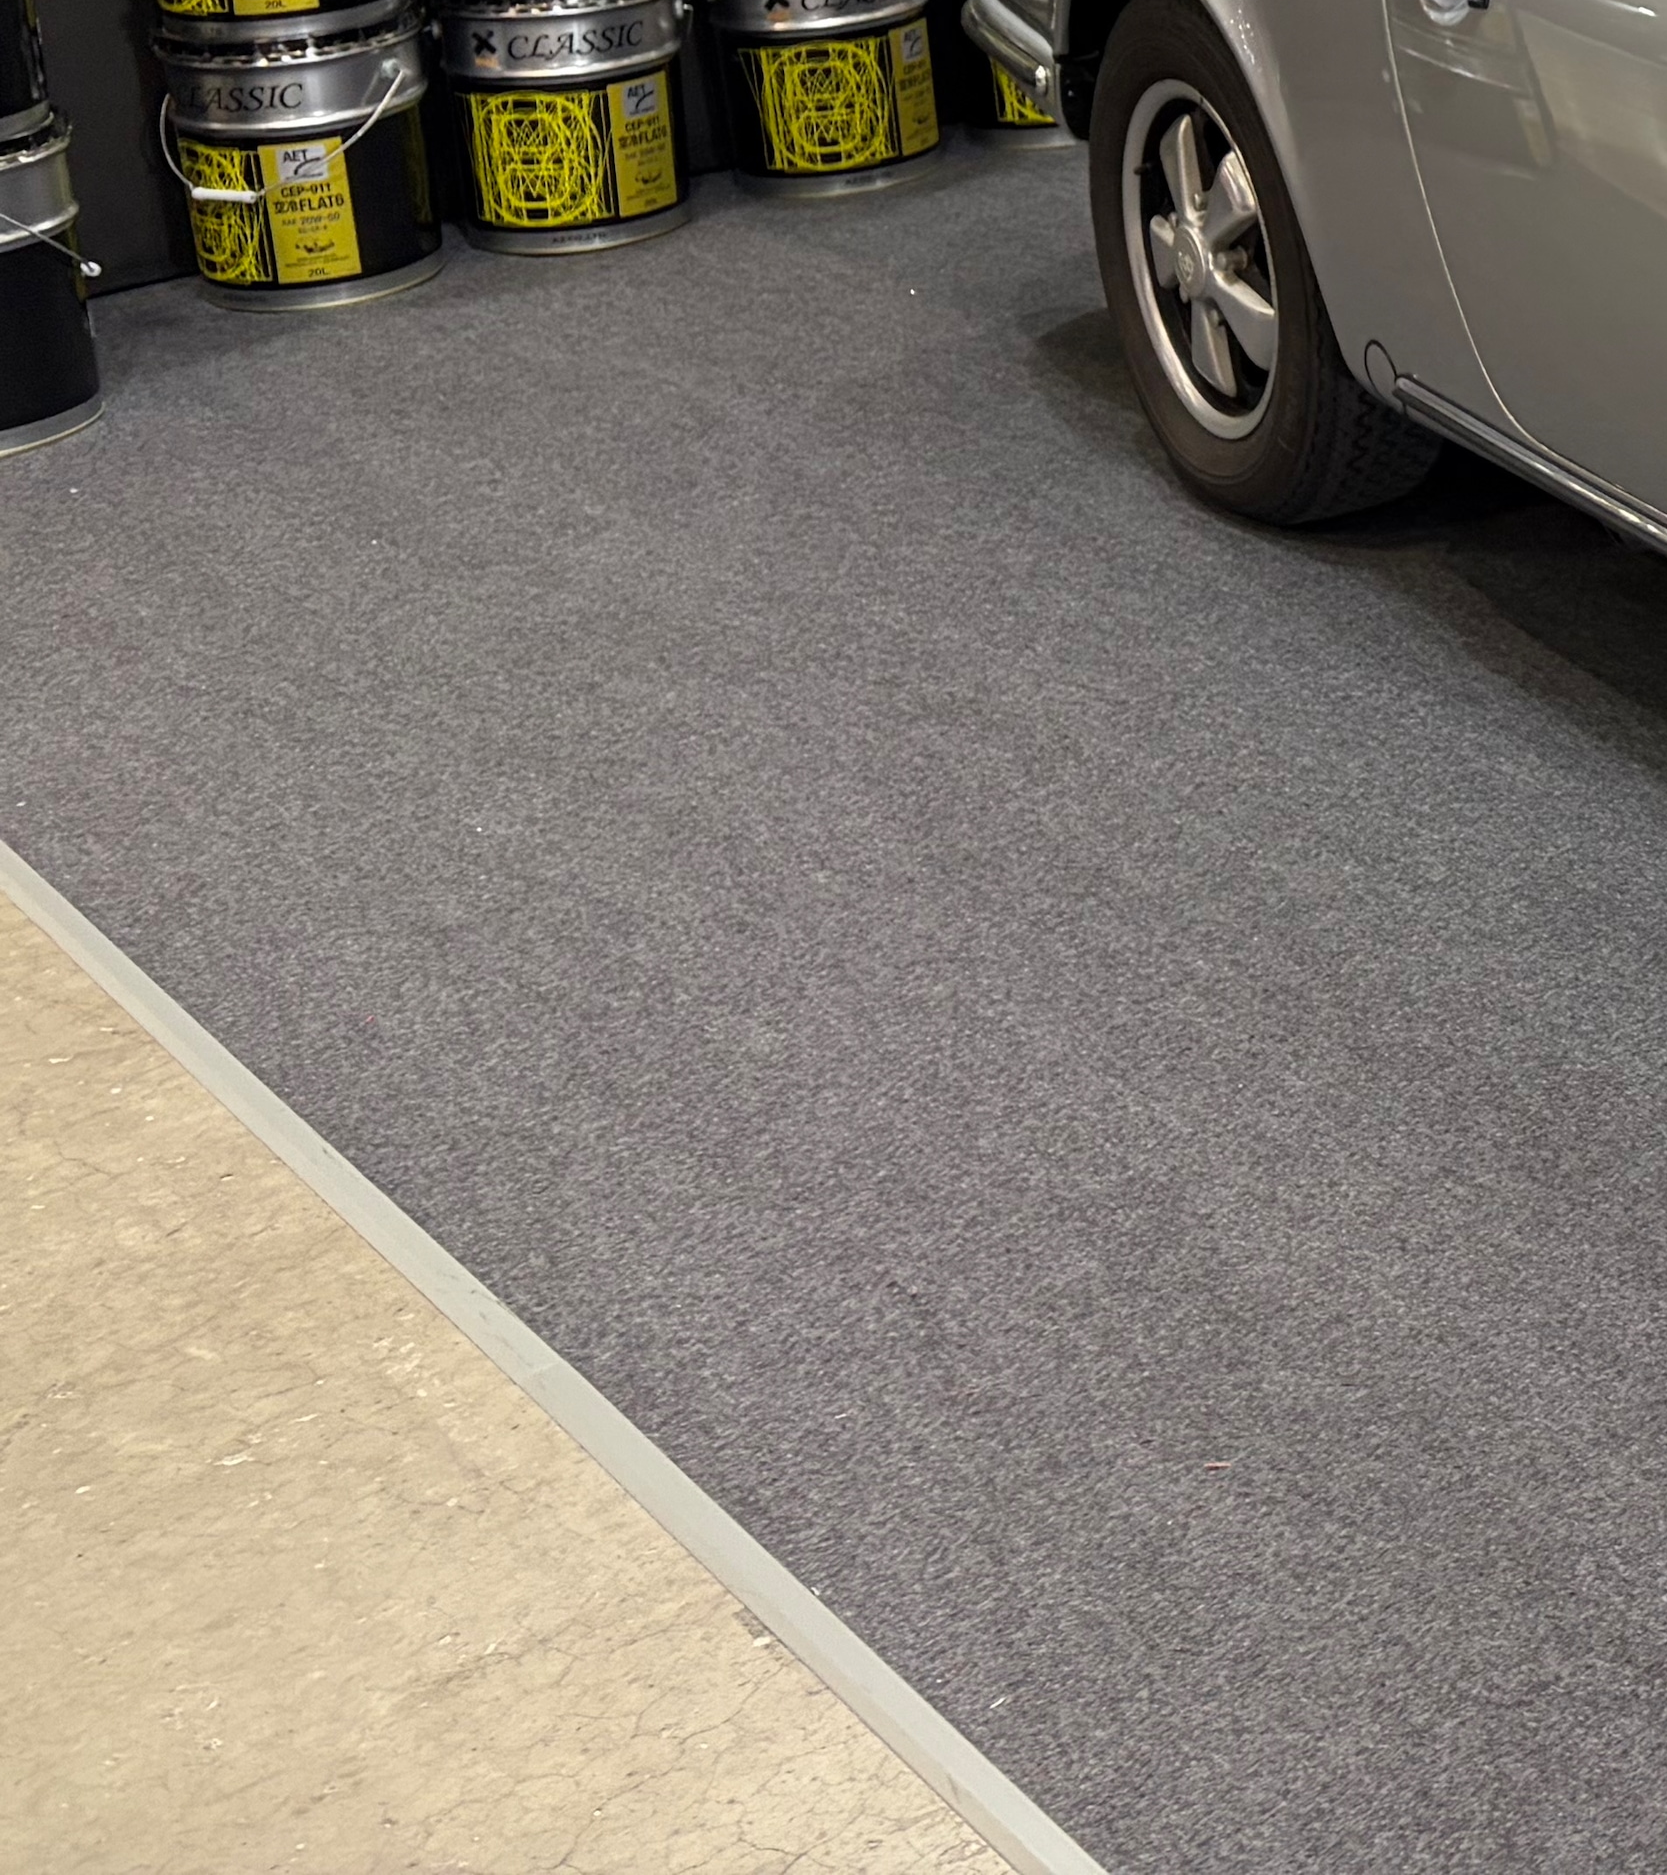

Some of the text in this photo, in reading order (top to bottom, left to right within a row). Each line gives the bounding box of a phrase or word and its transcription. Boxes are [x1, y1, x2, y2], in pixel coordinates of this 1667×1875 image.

[506, 20, 644, 61] CLASSIC
[180, 82, 304, 114] LASSIC
[282, 149, 310, 163] AET
[280, 181, 332, 199] CEP-911
